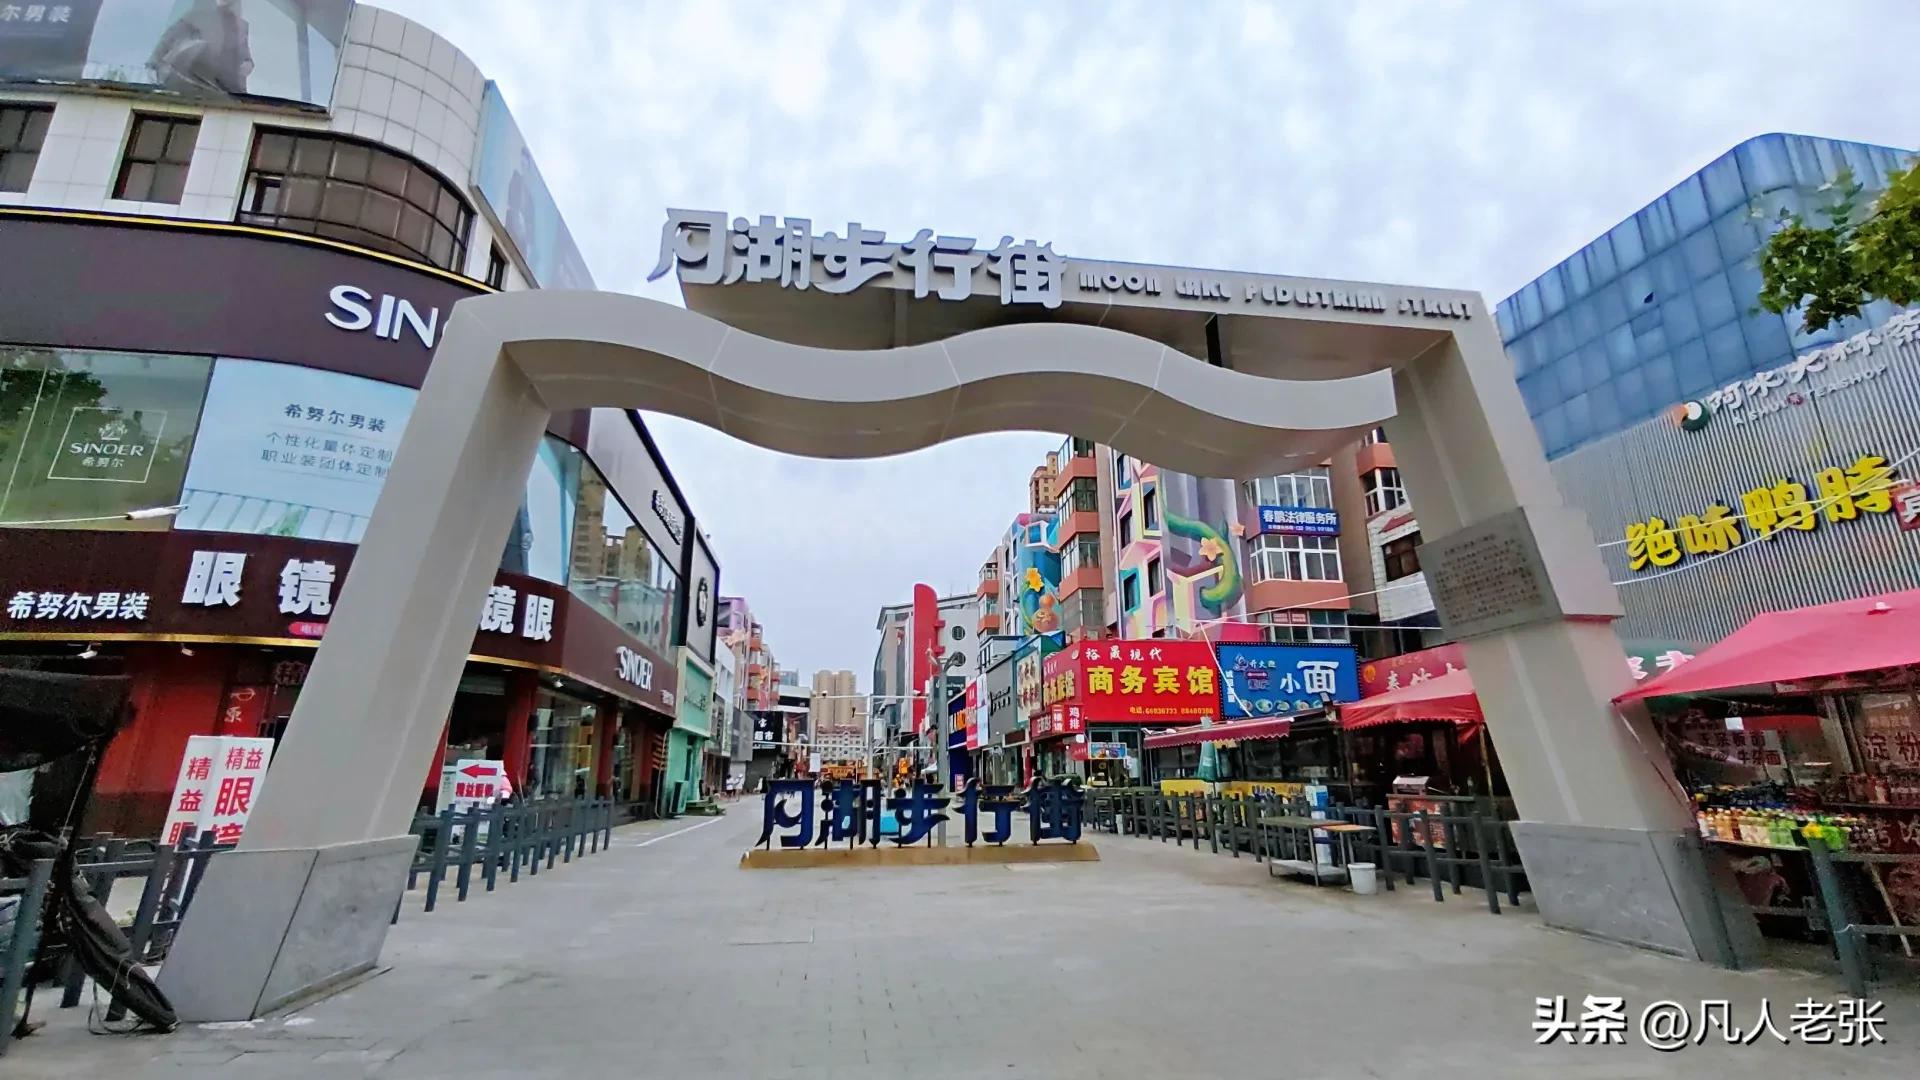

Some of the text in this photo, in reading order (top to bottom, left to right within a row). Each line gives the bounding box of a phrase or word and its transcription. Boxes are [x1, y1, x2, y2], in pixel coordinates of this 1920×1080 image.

[647, 207, 1067, 310] 月湖步行街
[1079, 271, 1473, 320] MOON LAKE PEDESTRIAN STREET
[325, 285, 449, 349] SIN
[284, 403, 387, 433] 希努尔男装
[69, 442, 145, 457] SINOER
[81, 457, 125, 467] 希努尔
[265, 431, 393, 463] 个性化量体定制
[260, 448, 389, 479] 职业装团体定制
[1625, 453, 1894, 573] 绝味鸭脖
[182, 550, 337, 616] 眼镜
[7, 591, 150, 621] 希努尔男装
[614, 645, 654, 692] SINOER
[1087, 665, 1214, 696] 商务宾馆
[1279, 660, 1340, 695] 小面
[1069, 706, 1081, 730] 鸡排
[225, 746, 264, 771] 精益
[754, 777, 1085, 848] 月湖步行街
